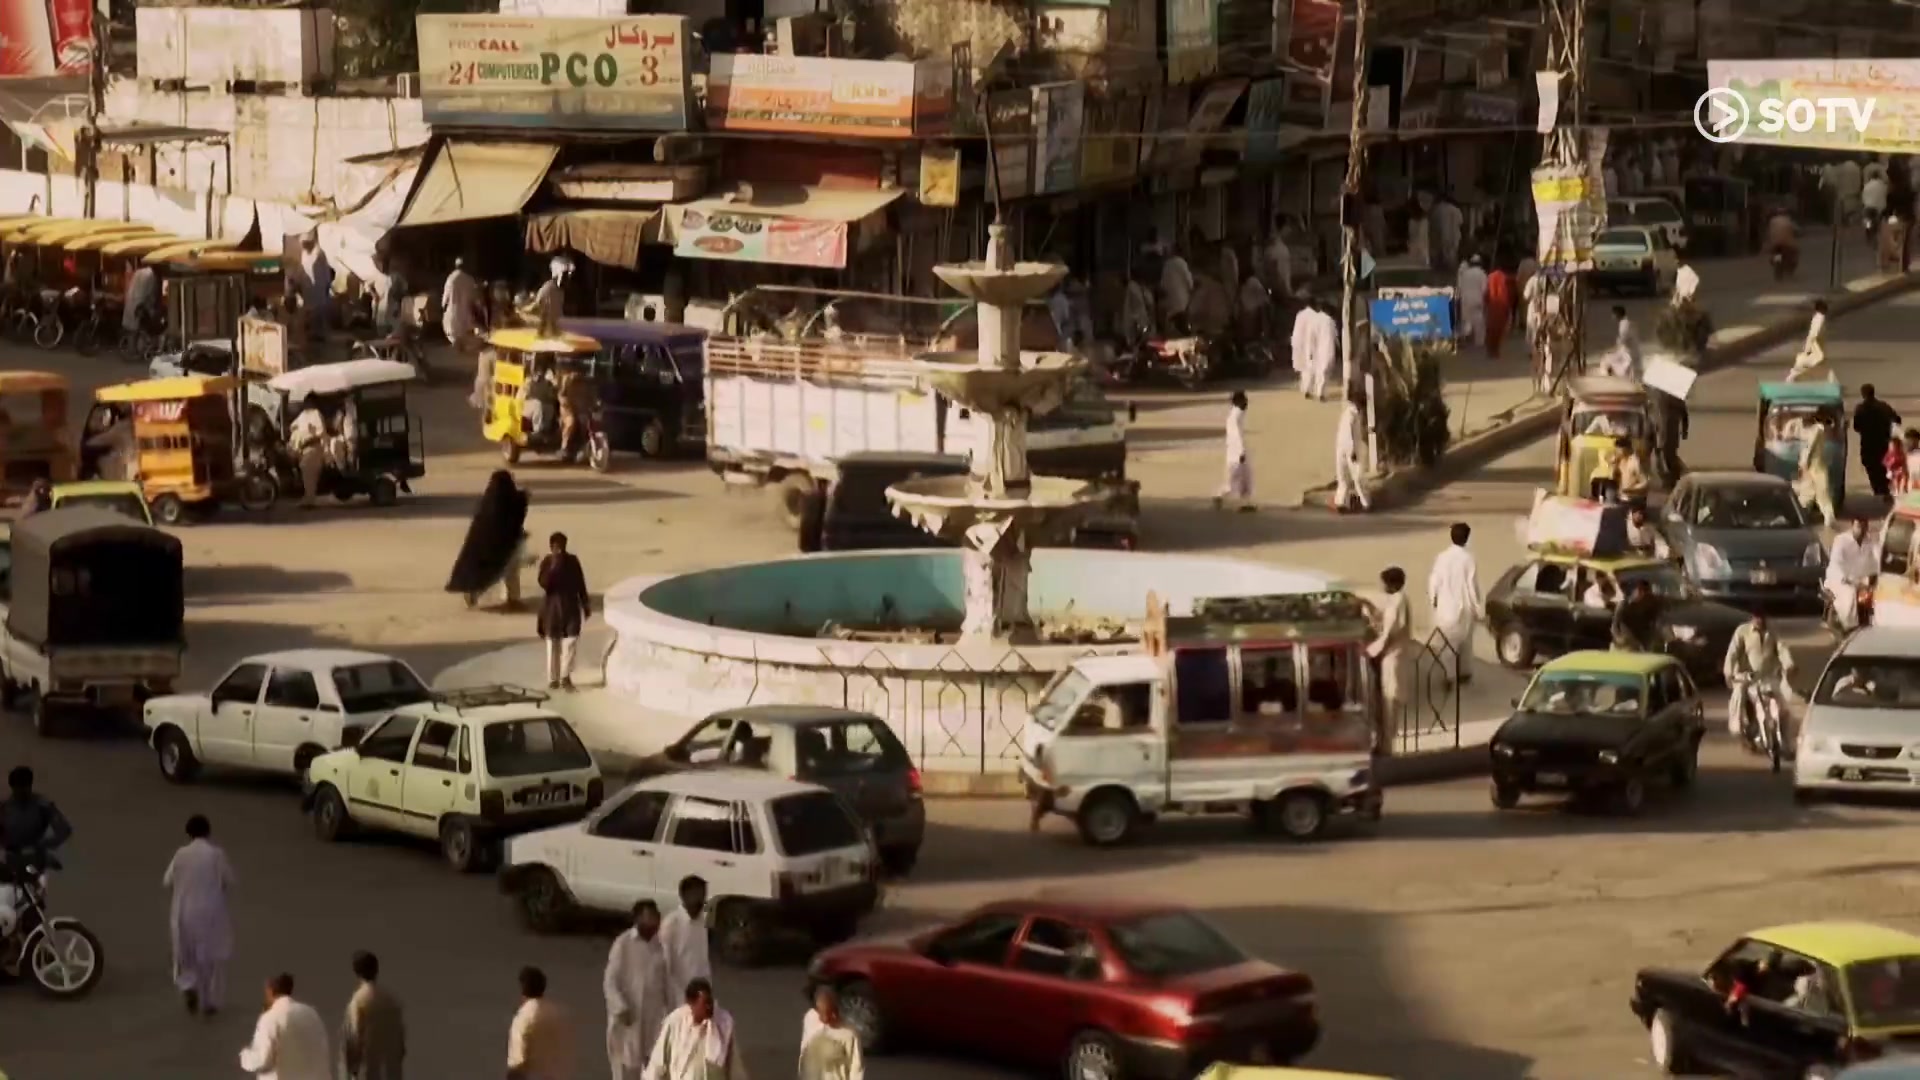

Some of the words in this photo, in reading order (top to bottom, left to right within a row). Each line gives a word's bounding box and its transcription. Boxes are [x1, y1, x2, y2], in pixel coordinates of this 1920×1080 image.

[448, 61, 475, 85] 24
[540, 52, 618, 88] PCO
[640, 55, 658, 86] 3
